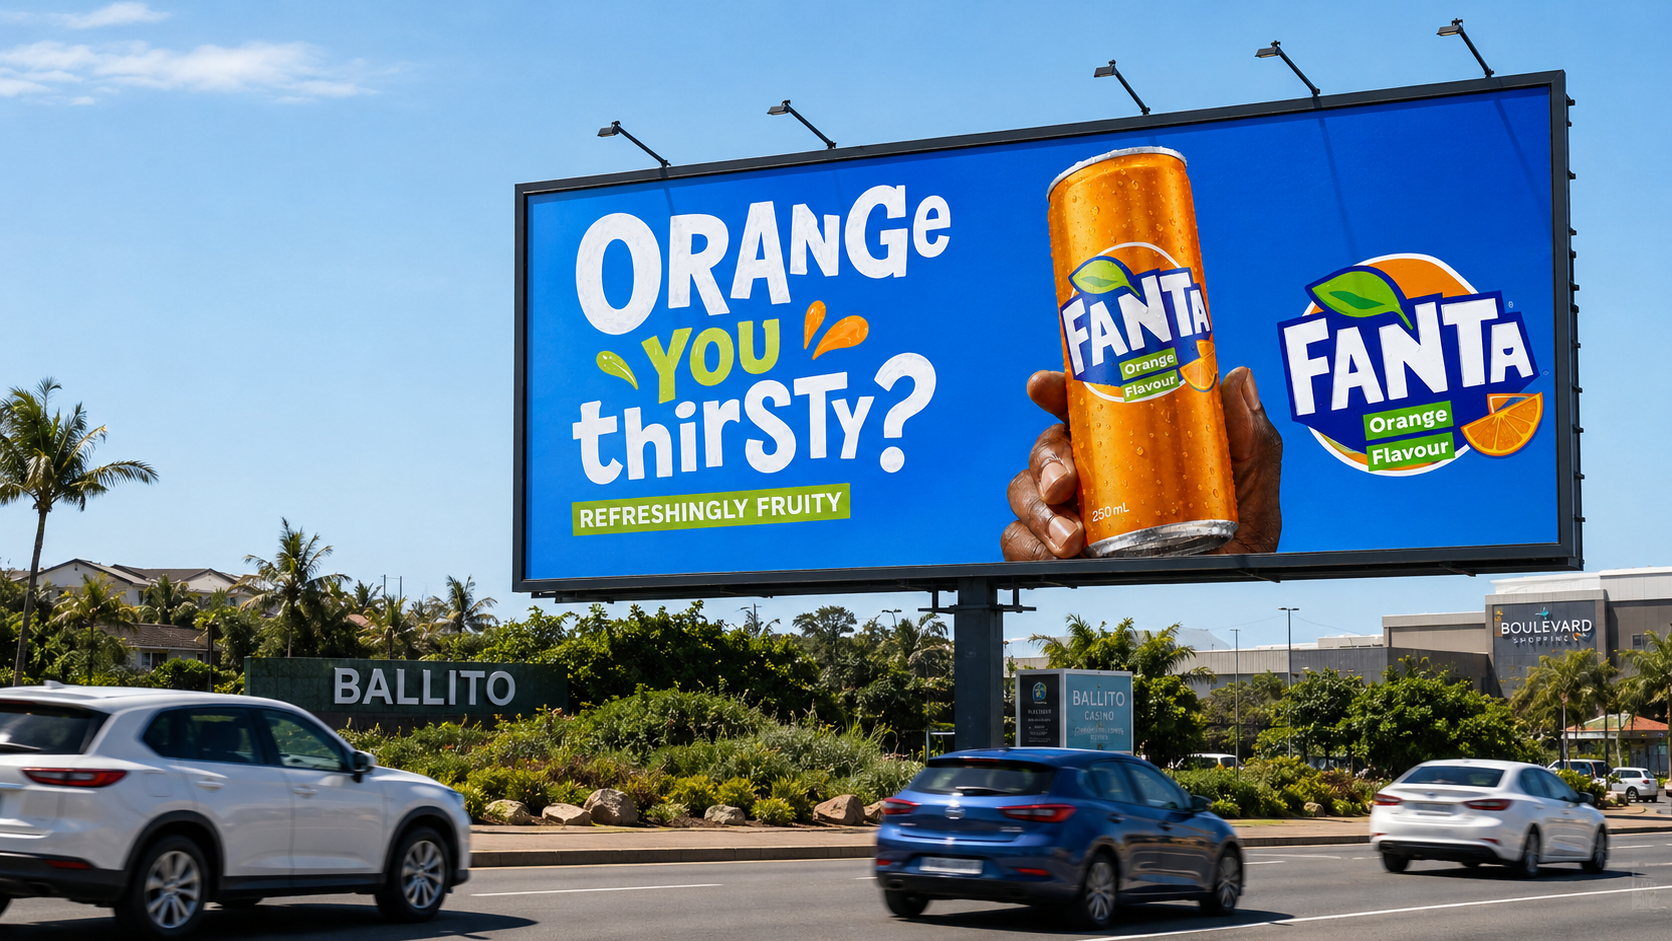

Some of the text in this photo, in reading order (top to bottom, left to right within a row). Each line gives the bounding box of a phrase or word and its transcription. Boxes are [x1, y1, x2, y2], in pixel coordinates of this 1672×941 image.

[1062, 274, 1211, 376] FANTA
[641, 318, 781, 405] YOU
[1124, 352, 1175, 377] Orange
[1283, 297, 1534, 416] FANTA
[1124, 374, 1176, 400] Flavour
[1369, 409, 1448, 434] Orange
[1372, 439, 1449, 466] Flavour
[579, 491, 842, 528] REFRESHINGLY FRUITY
[1092, 502, 1130, 522] 250 mL
[1501, 619, 1592, 635] BOULEVARD
[334, 667, 516, 707] BALLITO
[1073, 690, 1125, 706] BALLITO
[1085, 711, 1114, 721] CASINO
